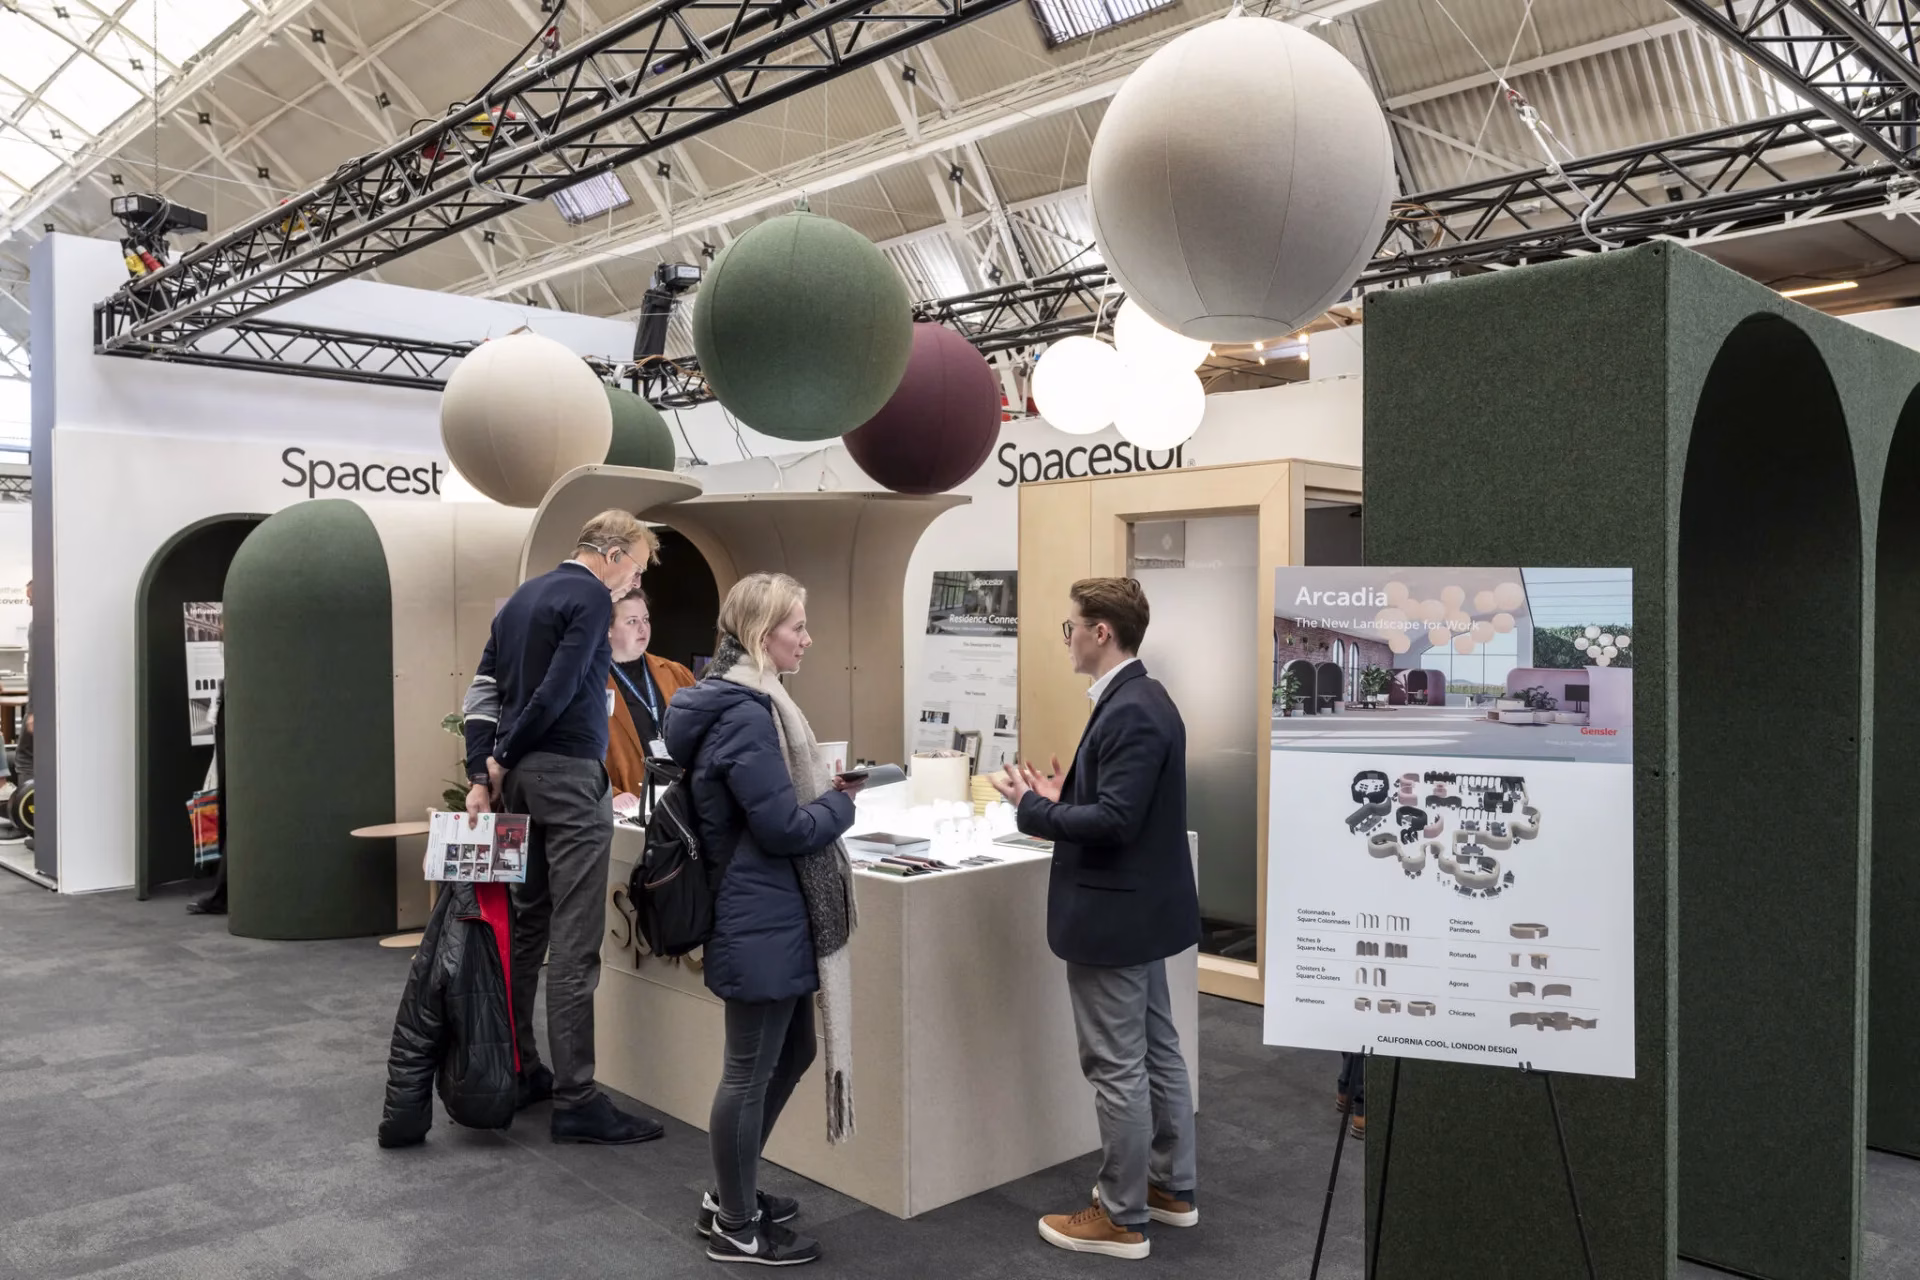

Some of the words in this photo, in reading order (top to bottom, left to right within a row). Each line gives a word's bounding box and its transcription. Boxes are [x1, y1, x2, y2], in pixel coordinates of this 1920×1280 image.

[997, 437, 1192, 487] Spacestor
[281, 447, 443, 499] Spacest
[974, 577, 1004, 587] Spacestor
[1294, 586, 1388, 607] Arcadia
[949, 614, 987, 624] Residence
[1295, 617, 1317, 628] The
[1321, 618, 1349, 629] New
[1353, 618, 1420, 631] Landscape
[1423, 620, 1442, 630] for
[1445, 620, 1480, 631] Work
[1580, 727, 1618, 736] Gensler
[1297, 908, 1331, 916] Colonnades
[1297, 916, 1317, 924] Square
[1317, 917, 1350, 925] Colonnades
[1449, 927, 1480, 935] Pantheons
[1296, 944, 1316, 952] Square
[1316, 945, 1336, 953] Niches
[1449, 951, 1477, 959] Rotundas
[1296, 972, 1315, 980] Square
[1316, 974, 1341, 982] Cloisters
[1448, 980, 1469, 988] Agoras
[1295, 996, 1325, 1005] Pantheons
[1448, 1009, 1476, 1018] Chicanes
[1377, 1035, 1423, 1046] CALIFORNIA
[1451, 1042, 1486, 1052] LONDON
[1487, 1045, 1518, 1054] DESIGN
